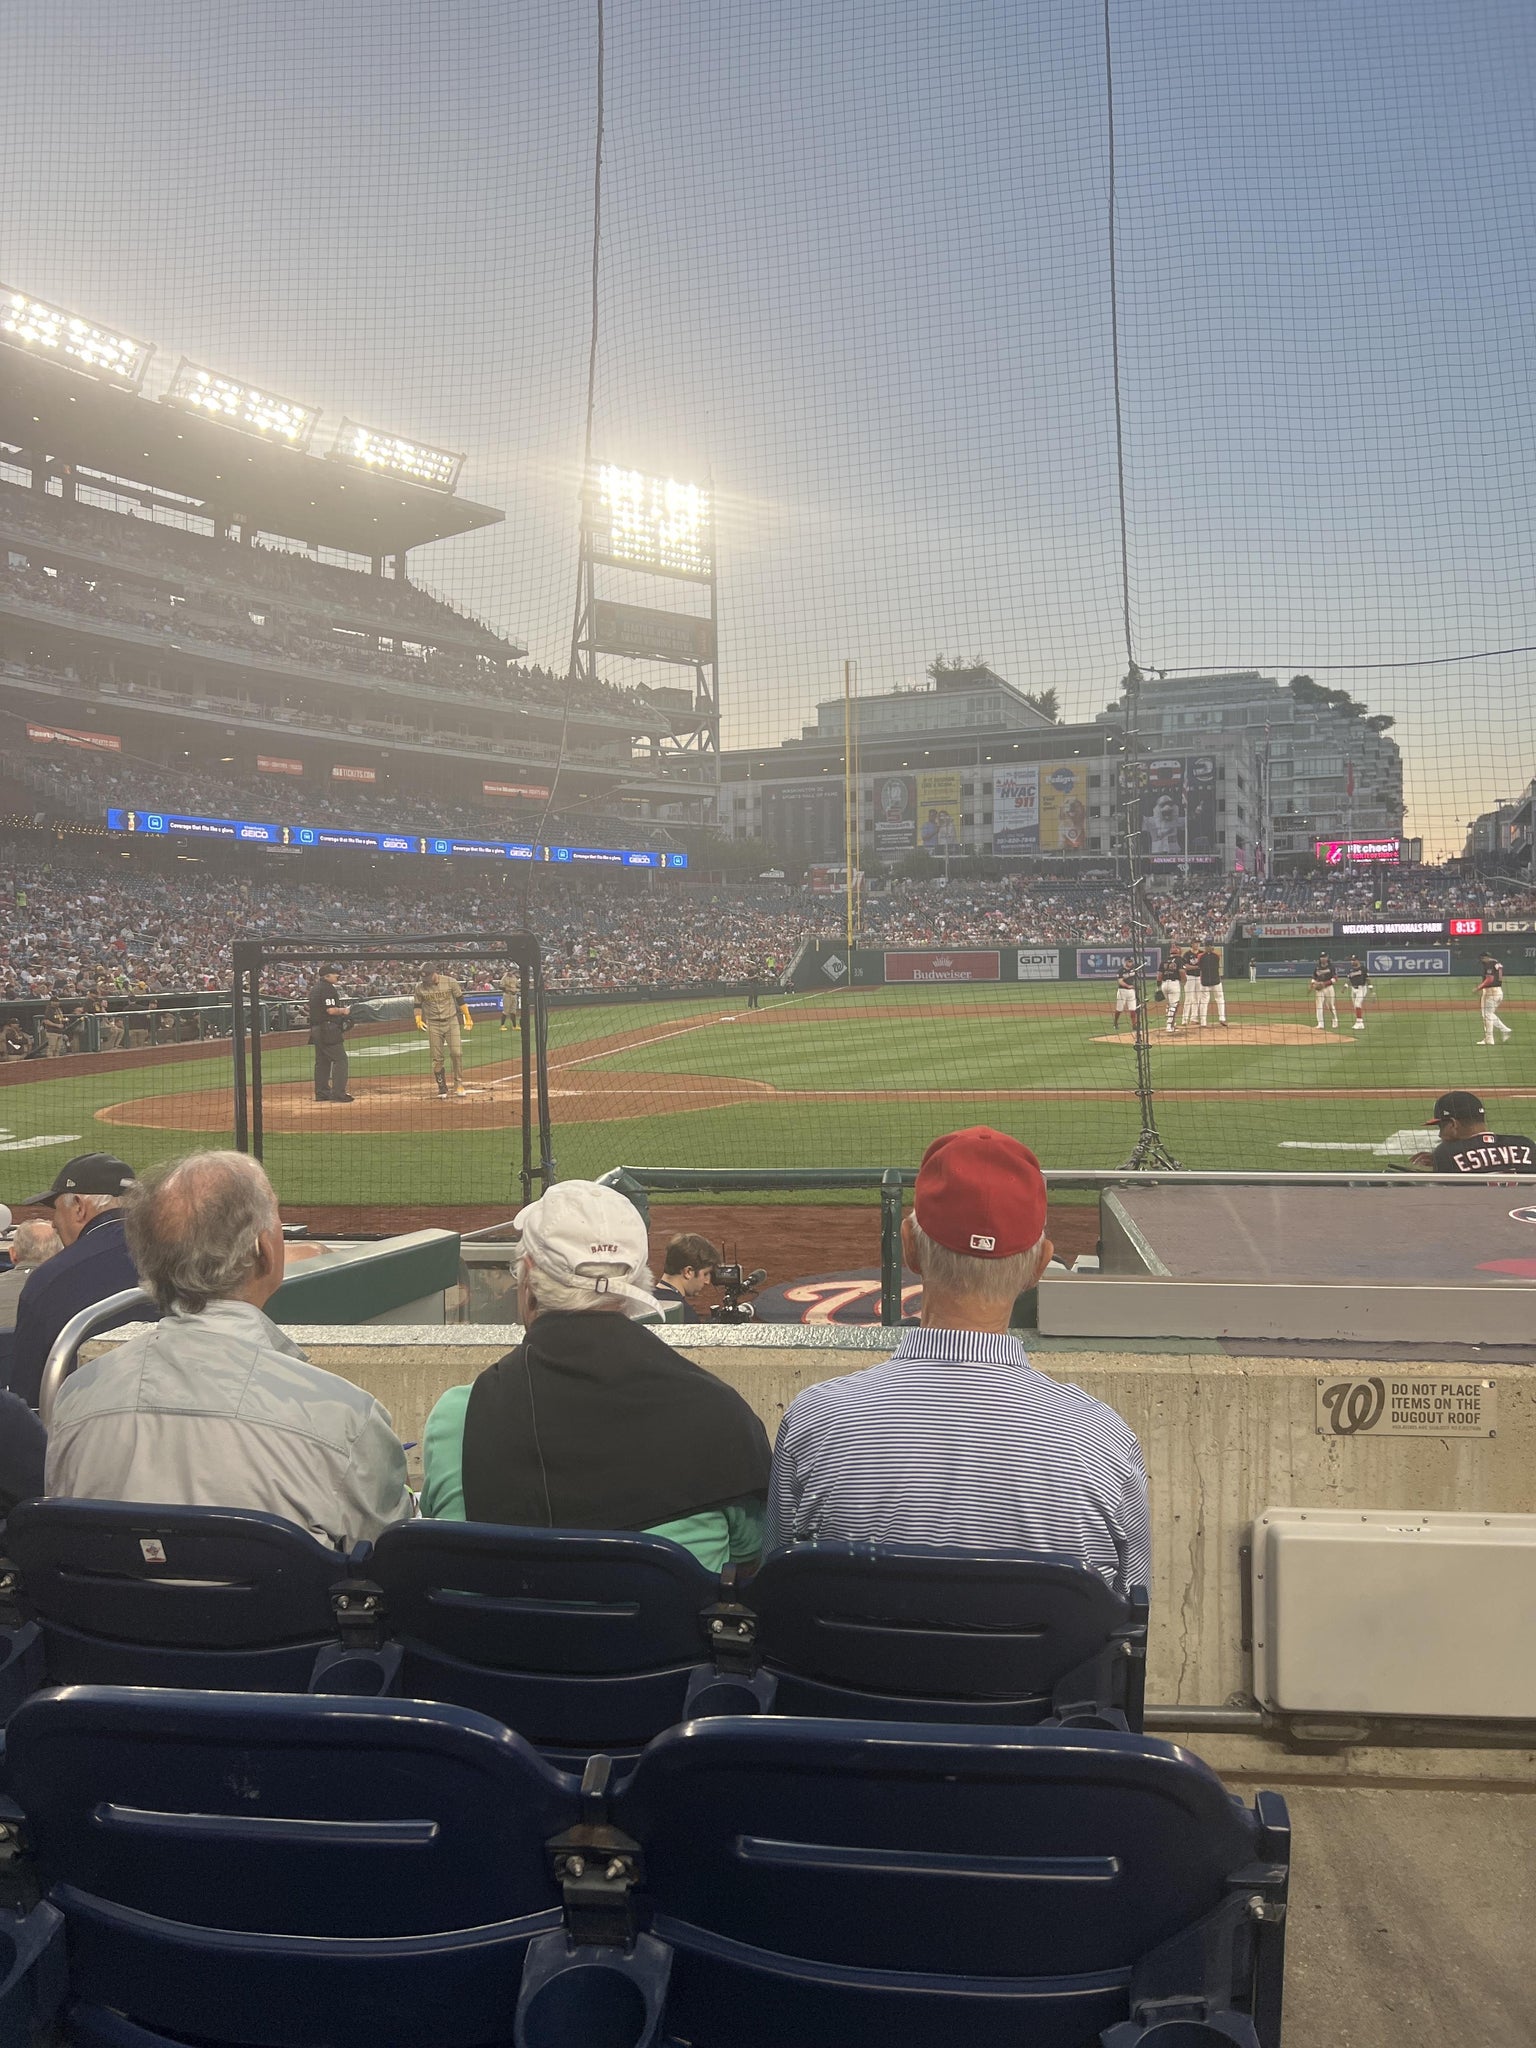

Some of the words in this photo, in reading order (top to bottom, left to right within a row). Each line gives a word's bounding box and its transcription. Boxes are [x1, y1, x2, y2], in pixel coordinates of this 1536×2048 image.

[1000, 786, 1036, 798] HVAC
[1014, 796, 1035, 808] 911
[170, 822, 192, 831] Coverage
[241, 829, 269, 839] GEICO
[1264, 926, 1296, 936] Harris
[1296, 925, 1331, 935] Teeter
[1342, 924, 1375, 934] WELCOME
[1375, 924, 1384, 934] TO
[1385, 923, 1423, 933] NATIONALS
[1423, 922, 1442, 932] PARK
[1455, 921, 1476, 933] 8:13
[1020, 955, 1058, 964] GDIT
[1394, 956, 1443, 970] Terra
[913, 969, 972, 980] Budweiser
[1453, 1145, 1532, 1172] ESTEVEZ
[590, 1244, 618, 1254] BATES
[1391, 1383, 1408, 1395] DO
[1412, 1384, 1438, 1396] NOT
[1441, 1384, 1481, 1396] PLACE
[1391, 1397, 1431, 1410] ITEMS
[1434, 1398, 1454, 1410] ON
[1456, 1398, 1481, 1410] THE
[1391, 1411, 1444, 1423] DUGOUT
[1448, 1412, 1481, 1424] ROOF
